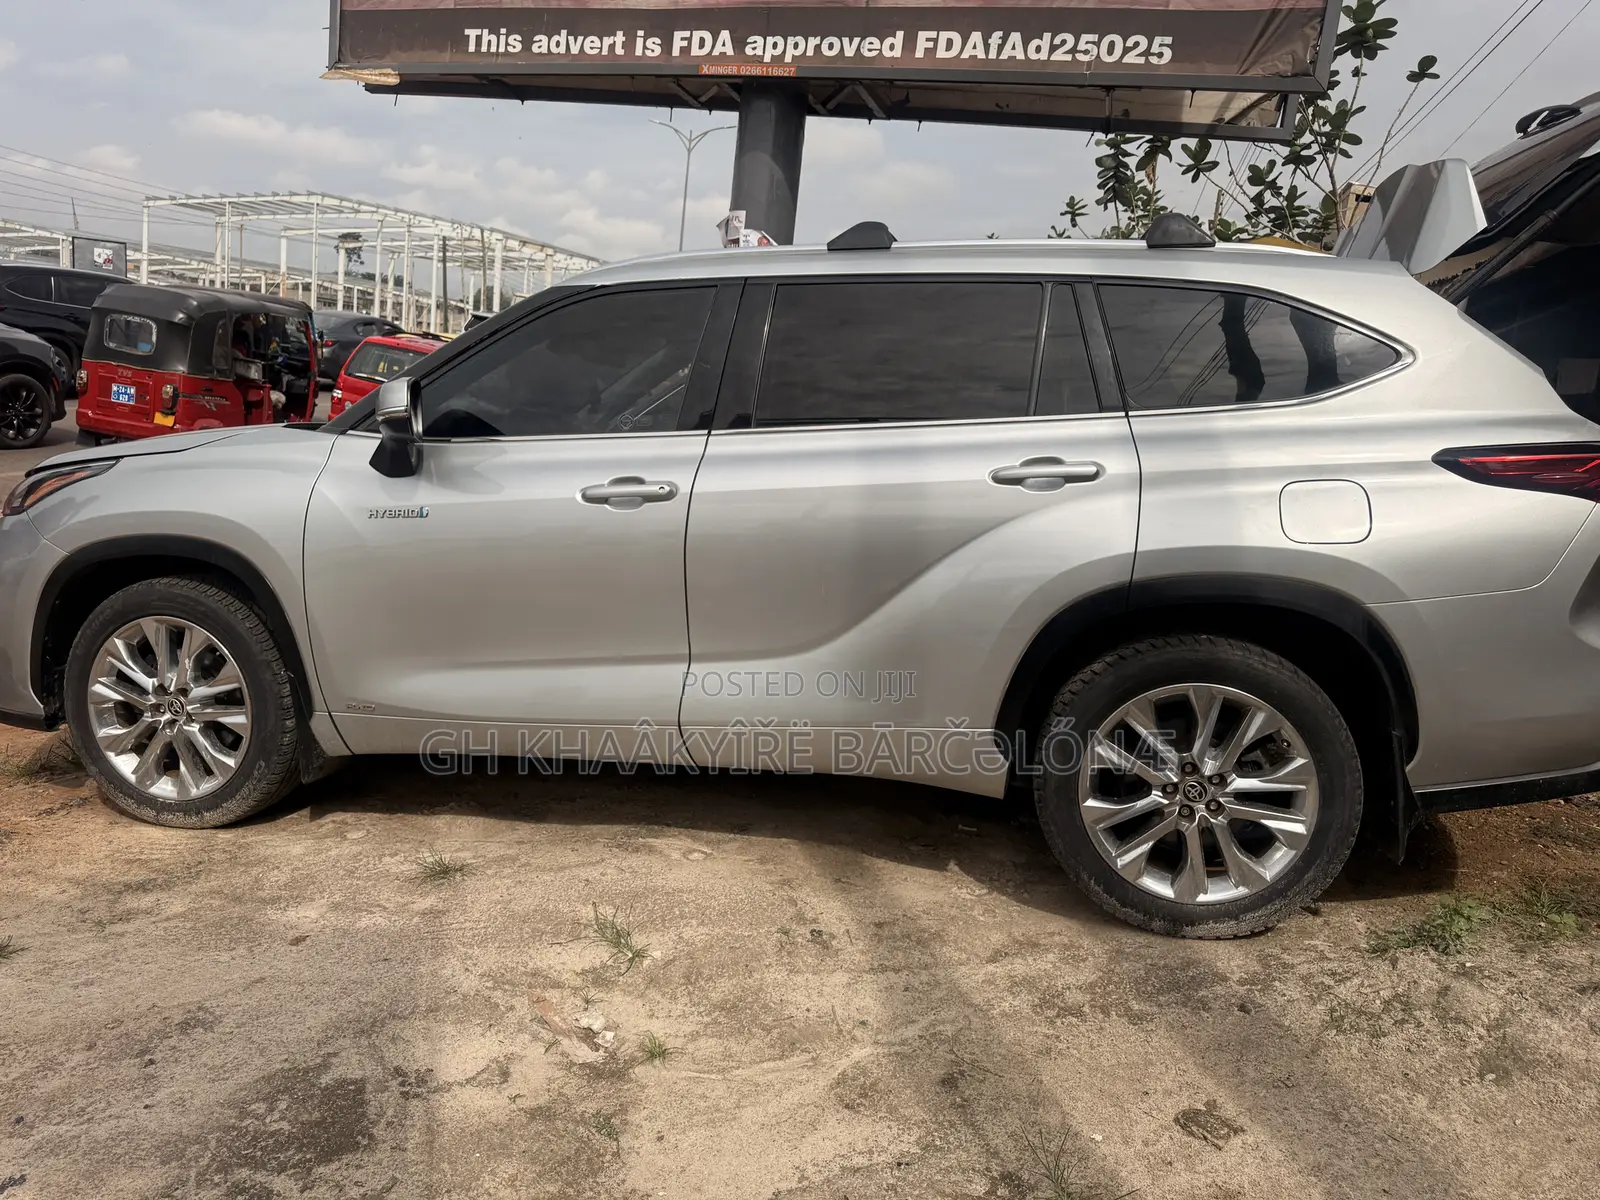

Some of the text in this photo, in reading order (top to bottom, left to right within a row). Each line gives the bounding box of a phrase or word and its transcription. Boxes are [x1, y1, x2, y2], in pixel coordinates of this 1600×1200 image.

[464, 28, 1173, 65] This advert is FDA approved FDAfAd25025
[701, 64, 795, 76] XMINGER 0266116627
[368, 508, 420, 519] HYBRID
